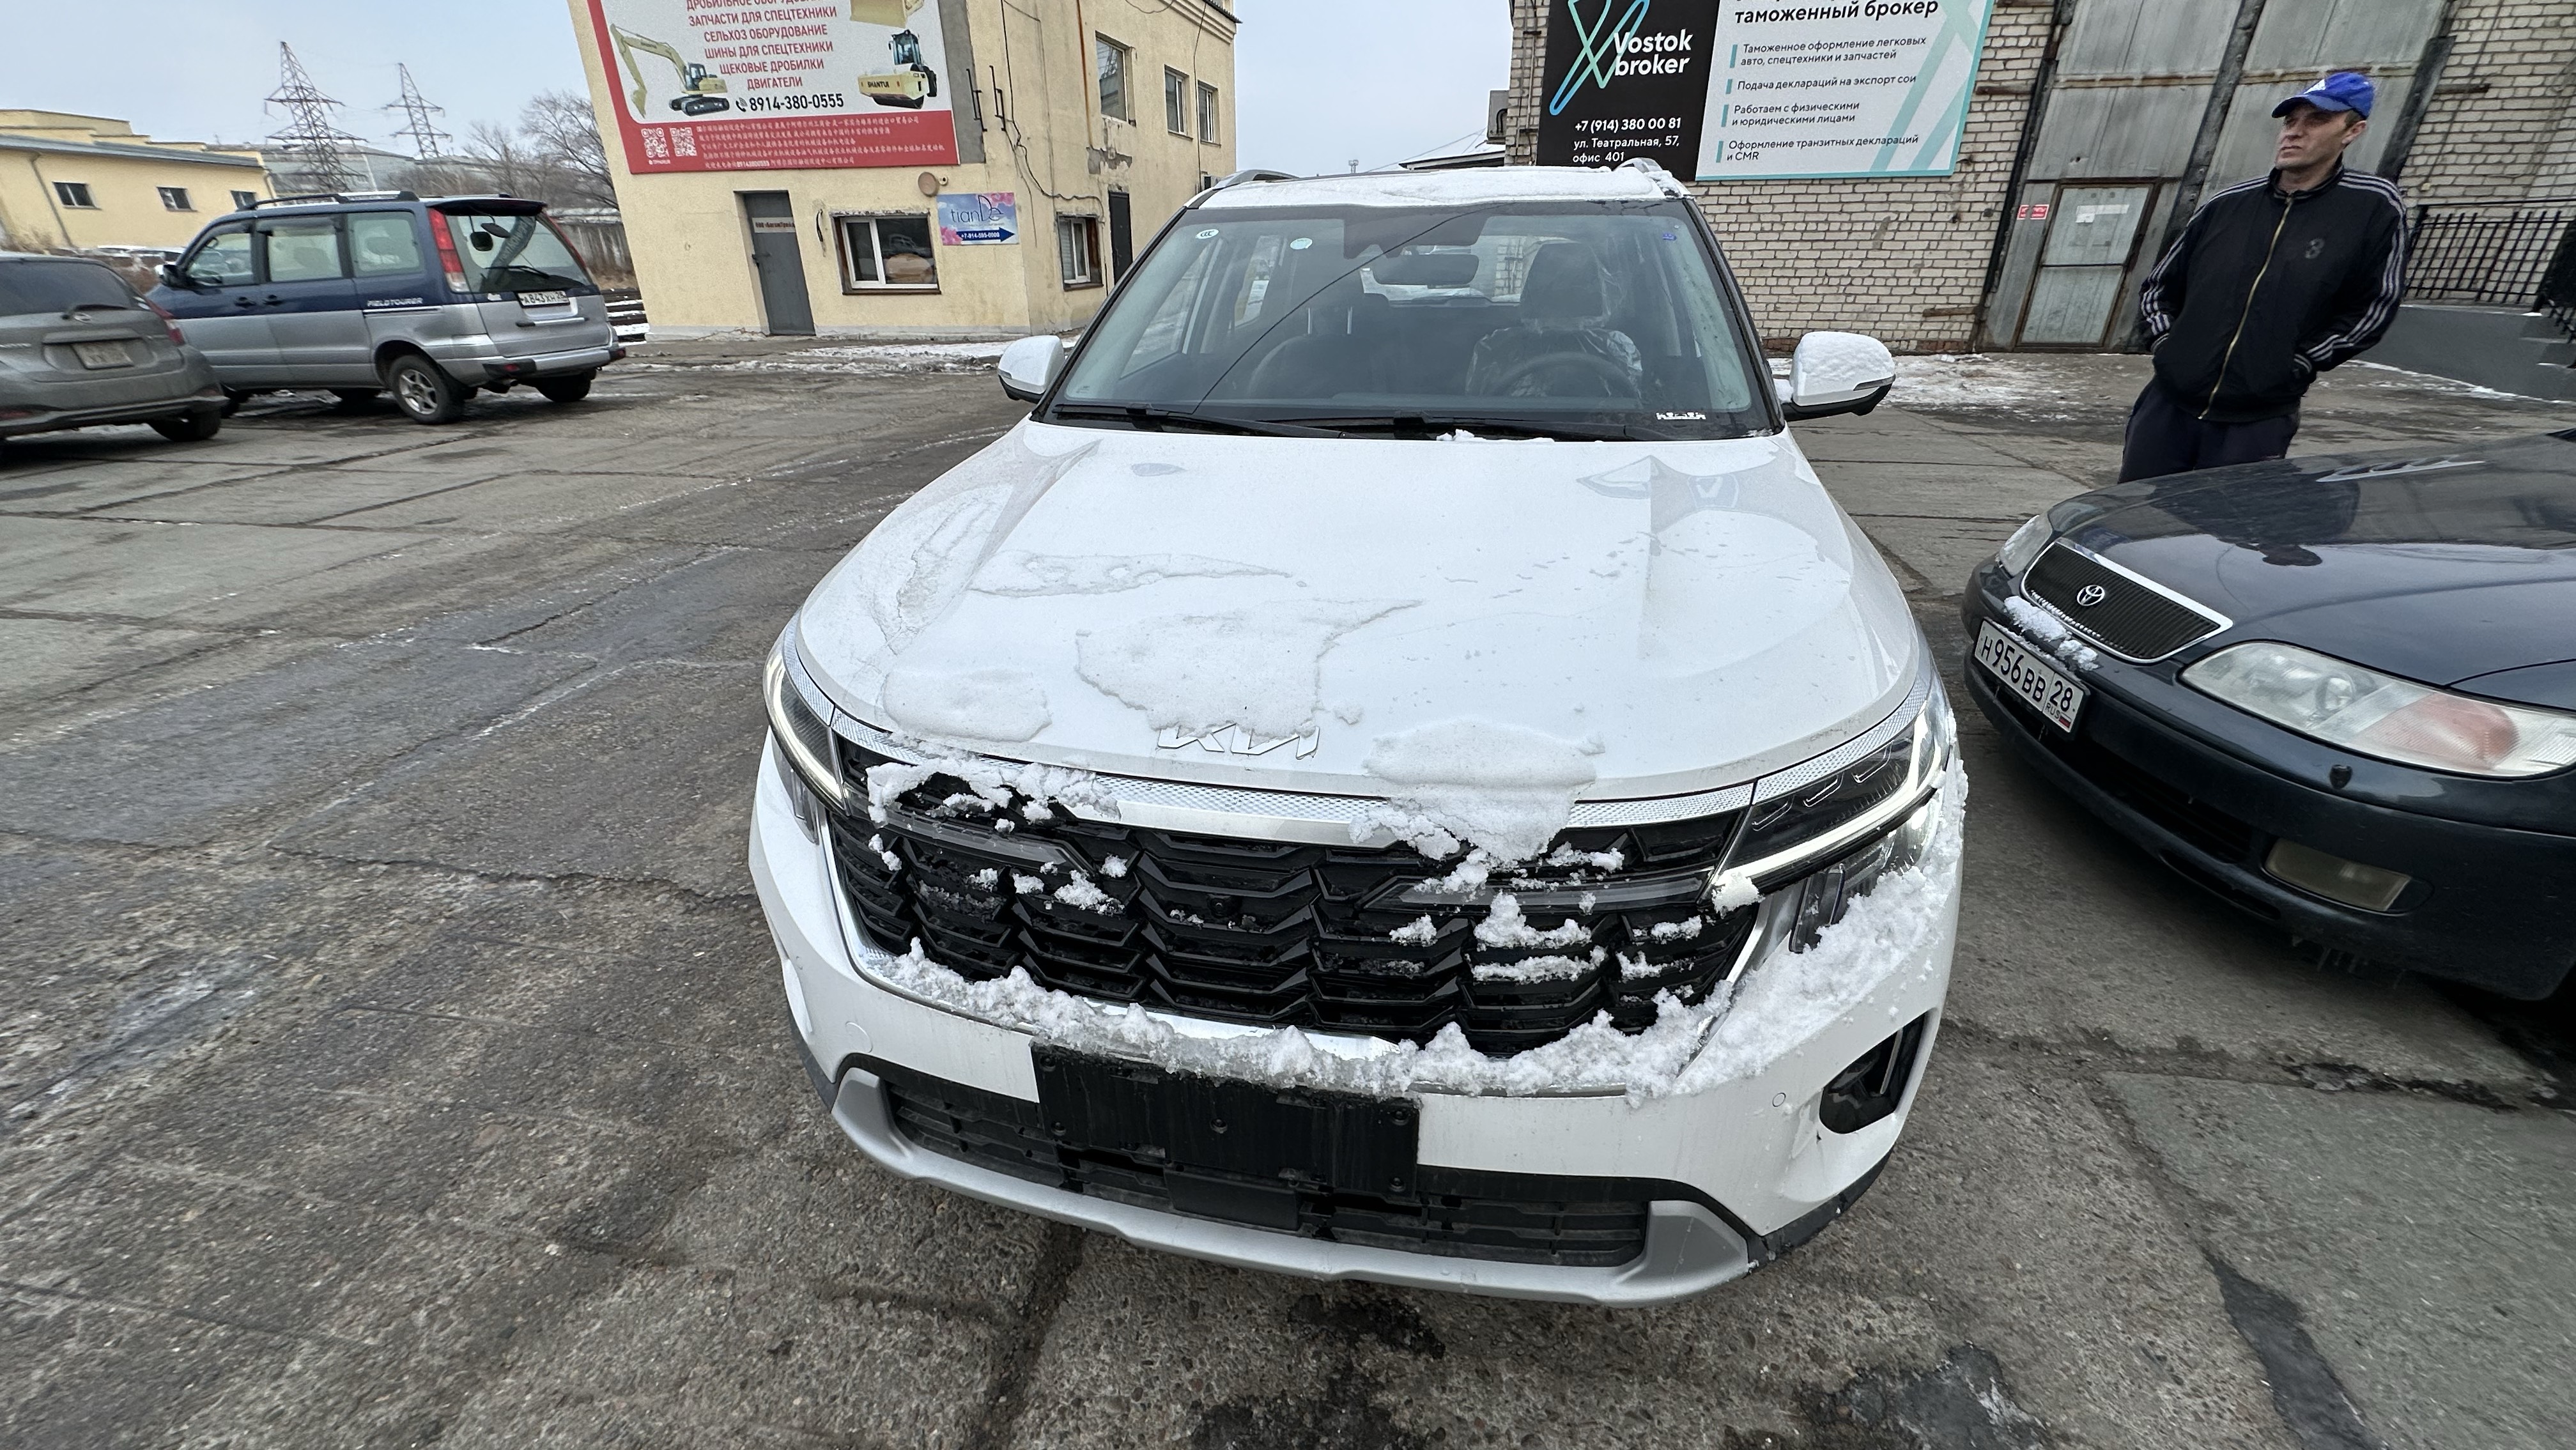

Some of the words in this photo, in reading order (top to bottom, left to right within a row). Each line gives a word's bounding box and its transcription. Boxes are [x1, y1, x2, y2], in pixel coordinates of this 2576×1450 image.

[689, 13, 739, 26] ЗАПЧАСТИ
[742, 12, 762, 24] ДЛЯ
[764, 6, 837, 21] СПЕЦТЕХНИКИ
[1734, 1, 1860, 23] таможенный
[1864, 0, 1939, 20] брокер
[704, 31, 747, 42] СЕЛЬХОЗ
[750, 24, 828, 40] ОБОРУДОВАНИЕ
[1614, 29, 1693, 53] Vostok
[705, 48, 736, 59] ШИНЫ
[739, 45, 759, 58] ДЛЯ
[762, 42, 833, 56] СПЕЦТЕХНИКИ
[1743, 43, 1805, 53] Таможенное
[1808, 40, 1874, 52] оформление
[1876, 36, 1927, 47] легковых
[1615, 54, 1690, 76] broker
[1741, 57, 1765, 66] авто,
[1768, 54, 1833, 65] спецтехники
[1843, 49, 1897, 61] запчастей
[720, 63, 768, 75] ЩЕКОВЫЕ
[771, 59, 824, 73] ДРОБИЛКИ
[747, 77, 803, 90] ДВИГАТЕЛИ
[1737, 81, 1774, 91] Подача
[1775, 77, 1838, 89] деклараций
[1853, 76, 1896, 86] экспорт
[750, 93, 844, 111] 8914-380-0555
[1734, 105, 1782, 114] Работаем
[1791, 102, 1860, 114] физическими
[1575, 120, 1589, 132] +7
[1591, 120, 1619, 134] (914)
[1621, 118, 1646, 130] 380
[1648, 118, 1666, 130] 00
[1668, 117, 1681, 128] 81
[1740, 115, 1814, 128] юридическими
[1816, 114, 1855, 124] лицами
[1573, 140, 1589, 150] ул.
[1591, 137, 1662, 150] Театральная,
[1665, 135, 1680, 146] 57,
[1729, 139, 1794, 151] Оформление
[1796, 138, 1854, 150] транзитных
[1855, 135, 1918, 147] деклараций
[1572, 153, 1600, 164] офис
[1605, 151, 1624, 162] 401
[1735, 151, 1759, 160] CMR
[951, 195, 1004, 222] tianDe
[2049, 681, 2073, 712] 28
[2046, 702, 2061, 720] RUS
